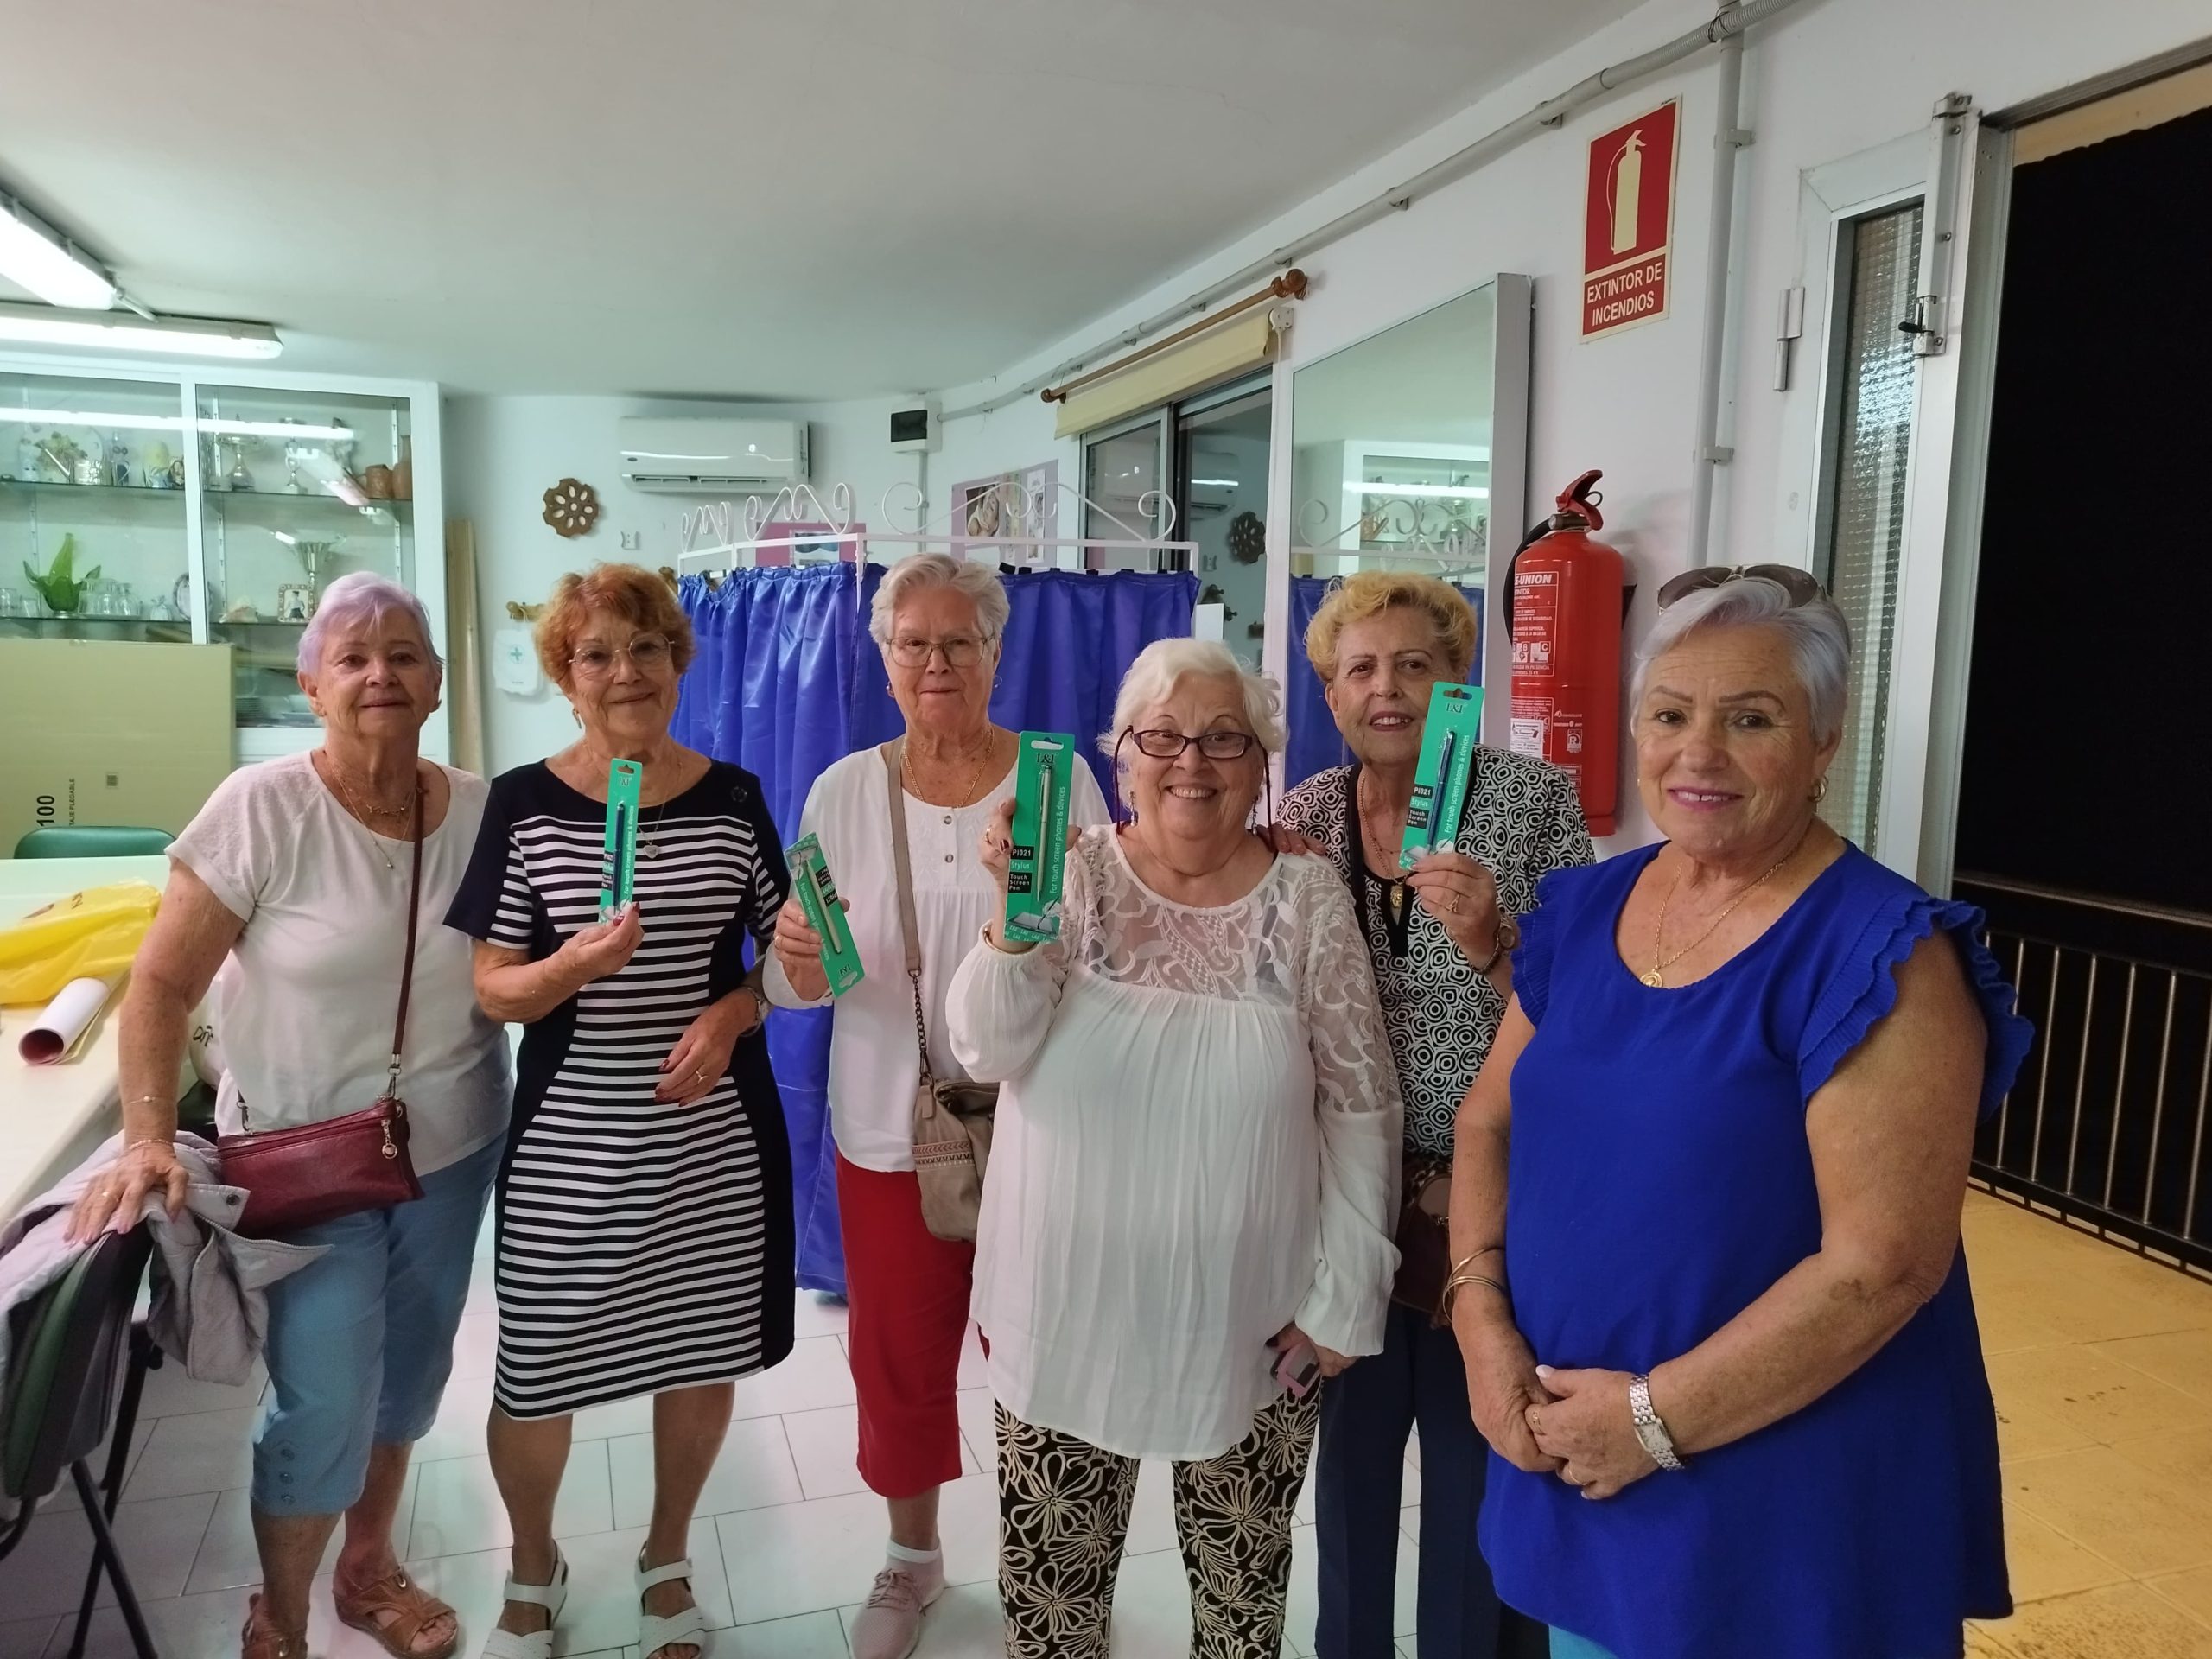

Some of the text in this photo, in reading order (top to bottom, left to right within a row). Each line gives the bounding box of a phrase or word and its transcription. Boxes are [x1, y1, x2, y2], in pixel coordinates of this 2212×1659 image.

[1587, 262, 1662, 303] EXTINTOR DE
[1592, 290, 1655, 327] INCENDIOS
[1541, 643, 1549, 652] C
[1057, 786, 1065, 810] devices
[1451, 785, 1459, 805] screen
[1455, 763, 1465, 785] phones
[36, 795, 55, 826] 100
[1011, 861, 1030, 870] Stylus
